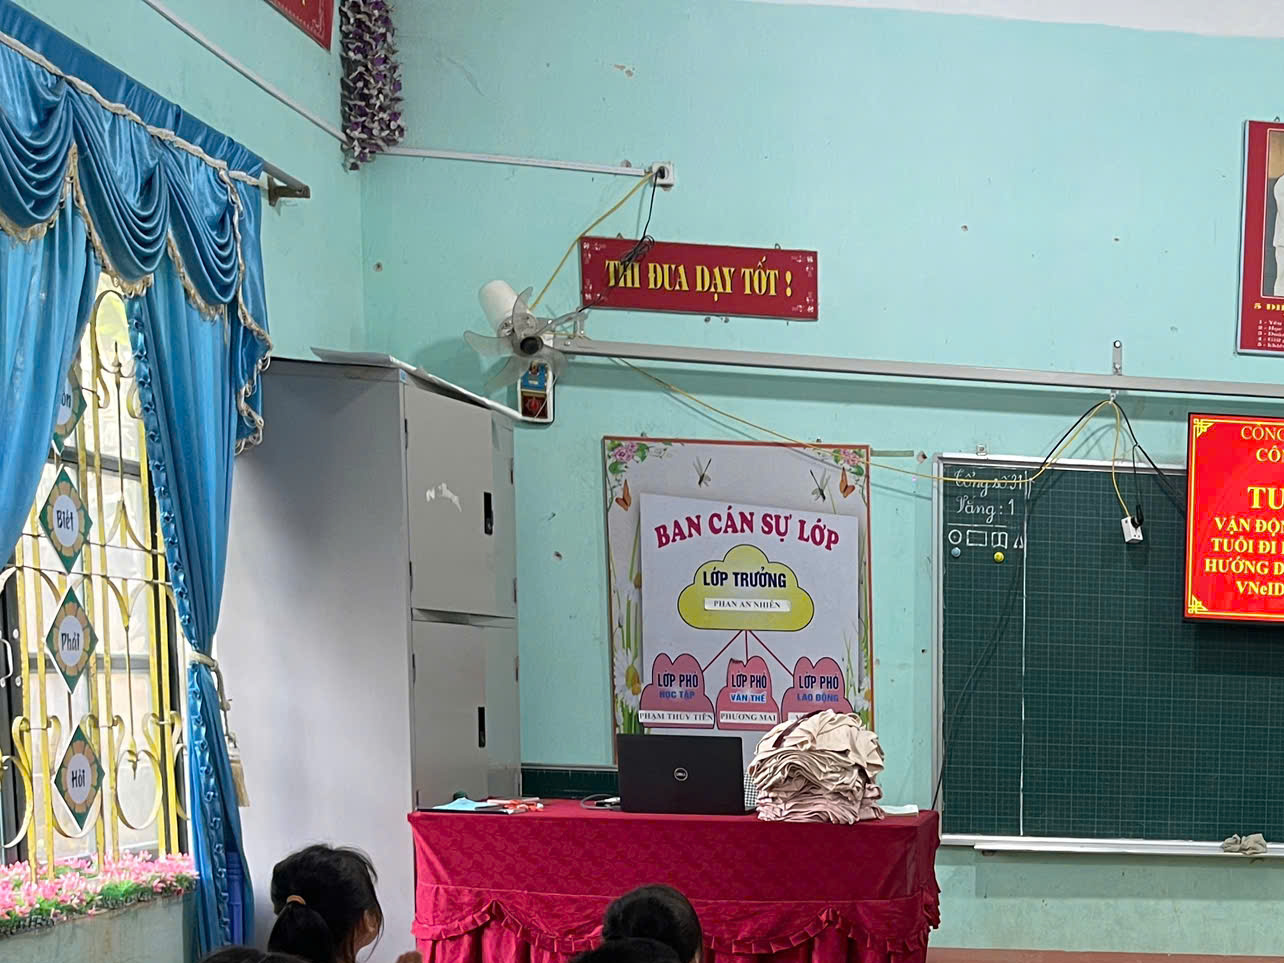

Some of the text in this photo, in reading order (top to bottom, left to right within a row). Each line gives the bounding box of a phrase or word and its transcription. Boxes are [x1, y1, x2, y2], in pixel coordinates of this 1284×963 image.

[605, 259, 641, 288] THI
[648, 263, 690, 292] ĐUA
[695, 265, 736, 302] DẠY
[741, 256, 779, 296] TỐT
[654, 505, 840, 551] BAN CÁN SỰ LỚP
[1215, 516, 1251, 535] VẬN
[1211, 536, 1254, 553] TUỔI
[1258, 540, 1277, 555] ĐI
[1204, 556, 1269, 576] HƯỚNG
[703, 566, 787, 588] LỚP TRƯỞNG
